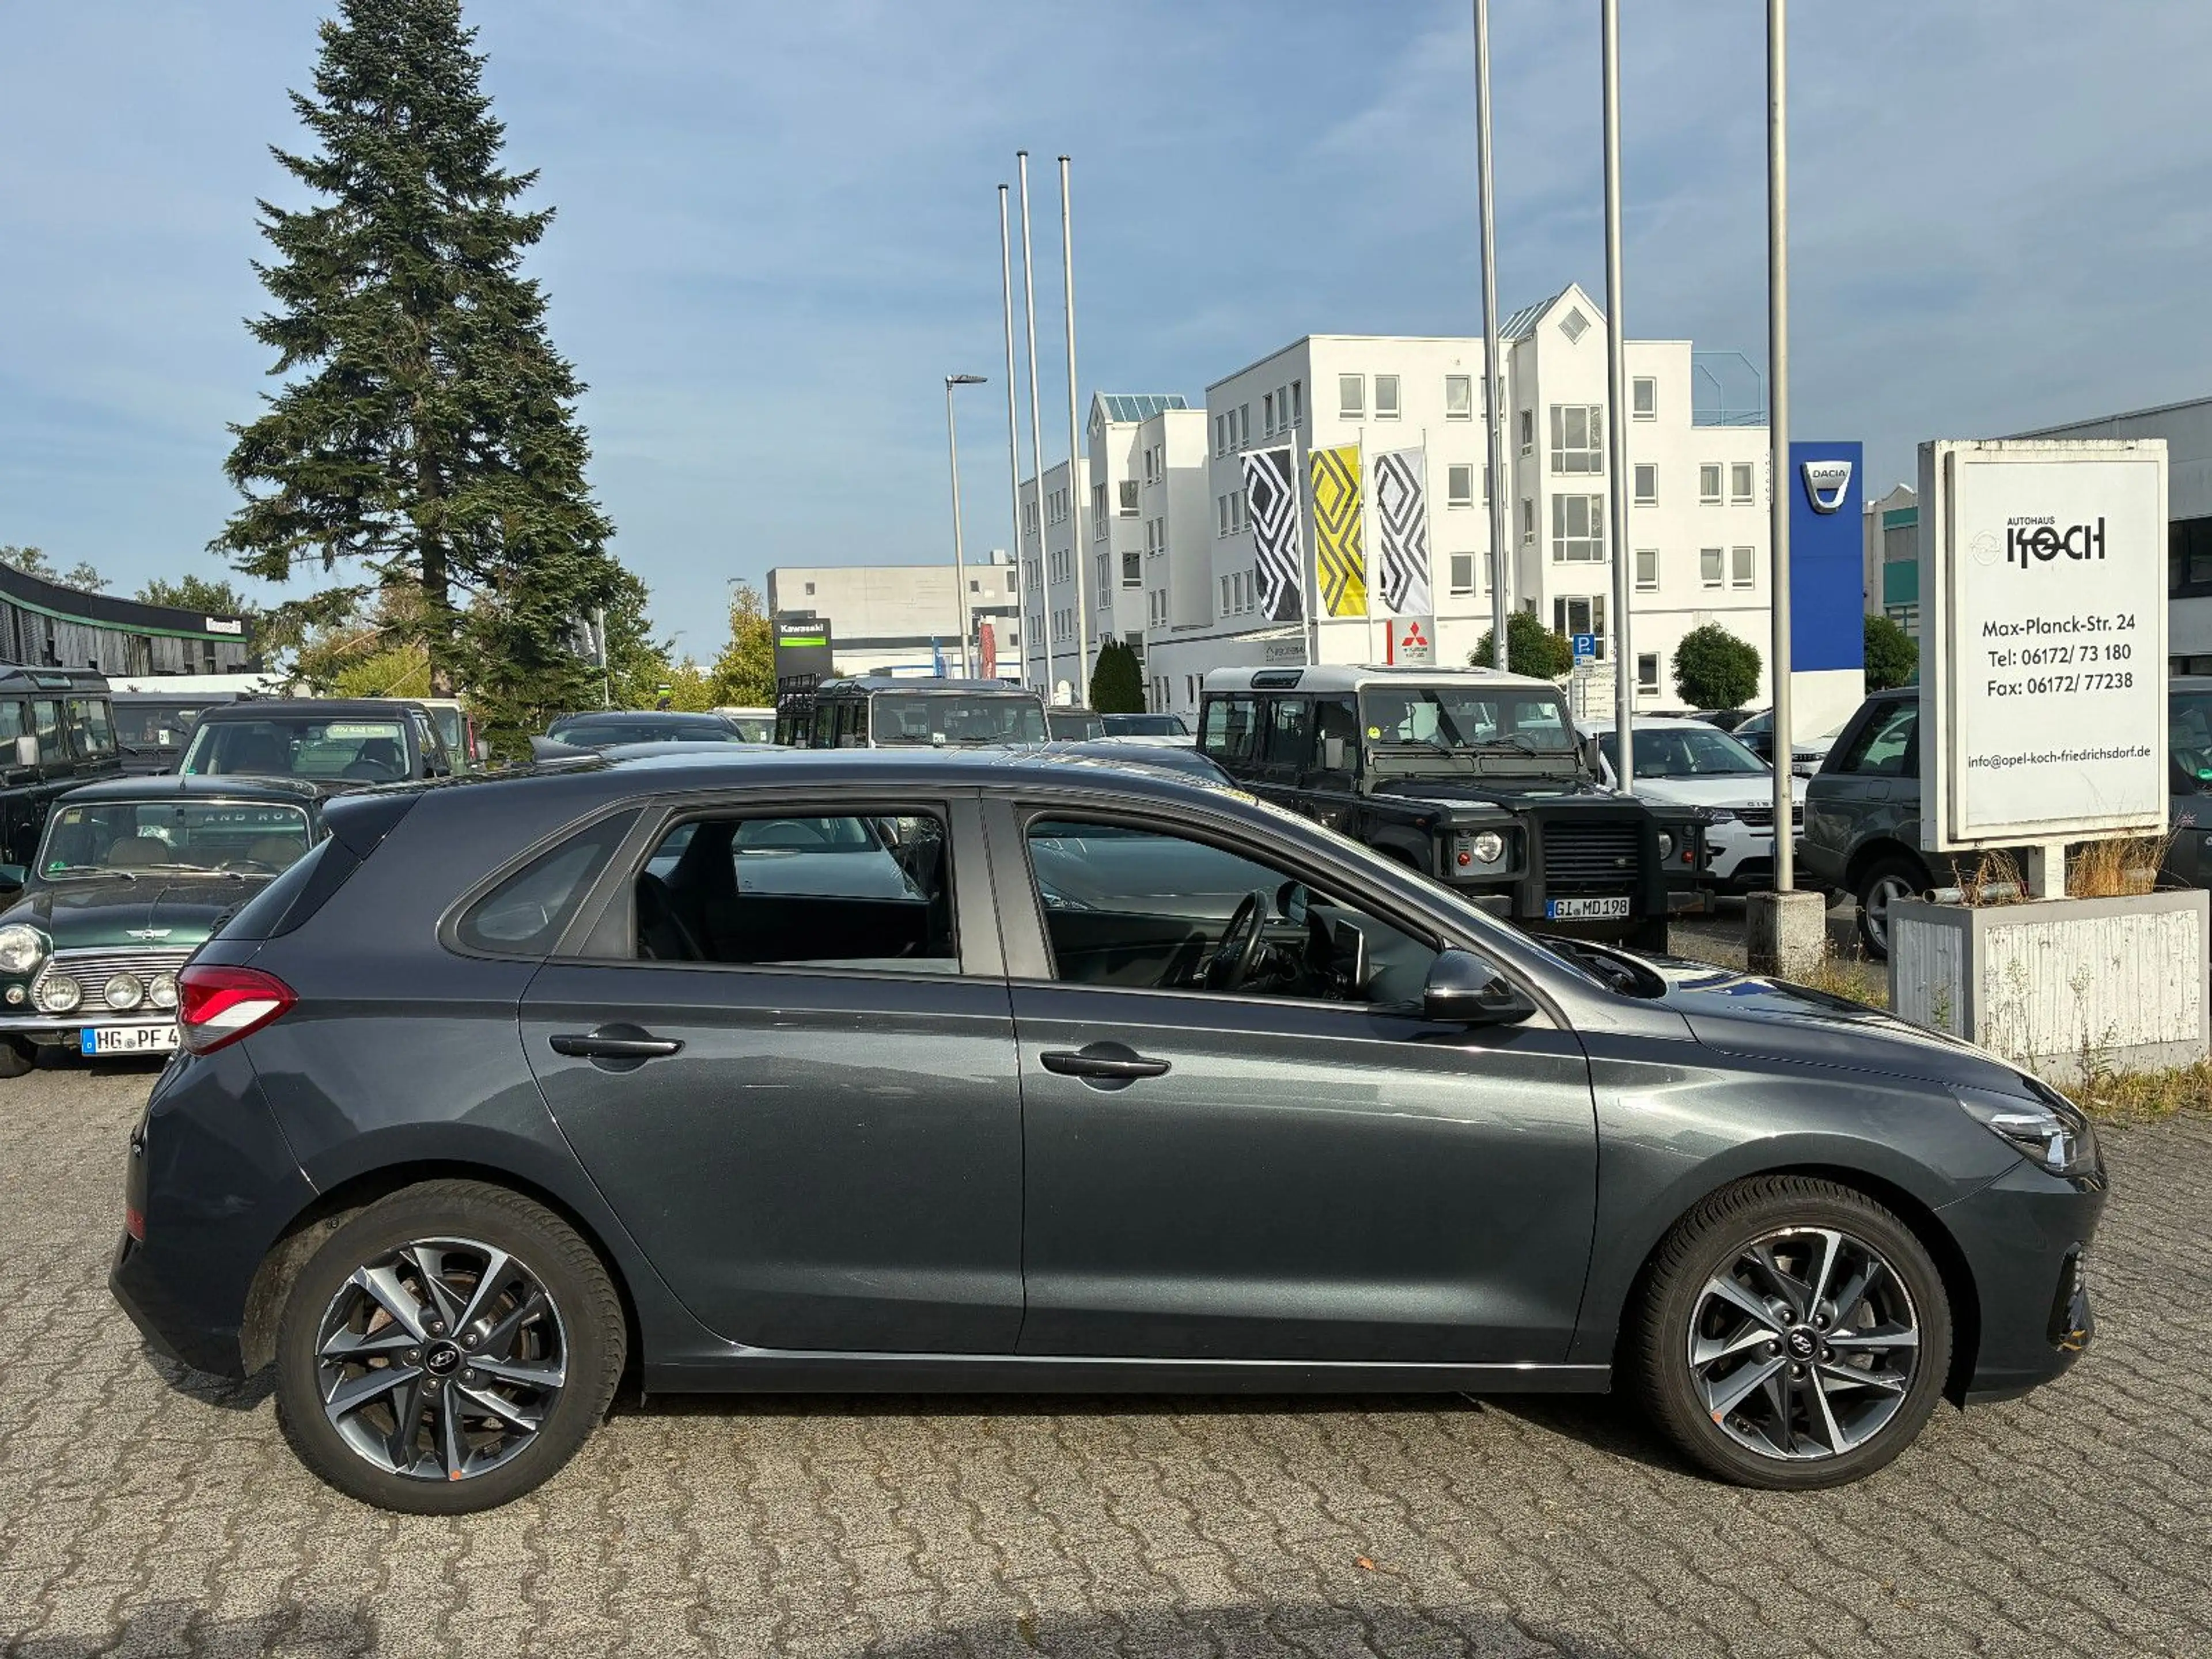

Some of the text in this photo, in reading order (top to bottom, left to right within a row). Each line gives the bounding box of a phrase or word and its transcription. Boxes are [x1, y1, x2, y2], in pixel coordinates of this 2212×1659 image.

[1812, 469, 1847, 478] DACIA
[2007, 516, 2055, 526] AUTOHAUS
[2007, 517, 2105, 569] KOCH
[781, 623, 824, 633] Kawasaki
[1982, 613, 2135, 637] Max-Planck-Str. 24
[1578, 637, 1590, 653] P
[1988, 644, 2131, 667] Tel: 06172/ 73 180
[1987, 672, 2133, 696] Fax: 06172/ 77238
[1968, 746, 2151, 769] info@opel-koch-friedrichsdorf.de
[204, 812, 298, 822] AND ROV
[1555, 899, 1627, 916] GI MD 198
[97, 1031, 122, 1049] HG
[137, 1029, 161, 1047] PF
[168, 1028, 179, 1046] 4
